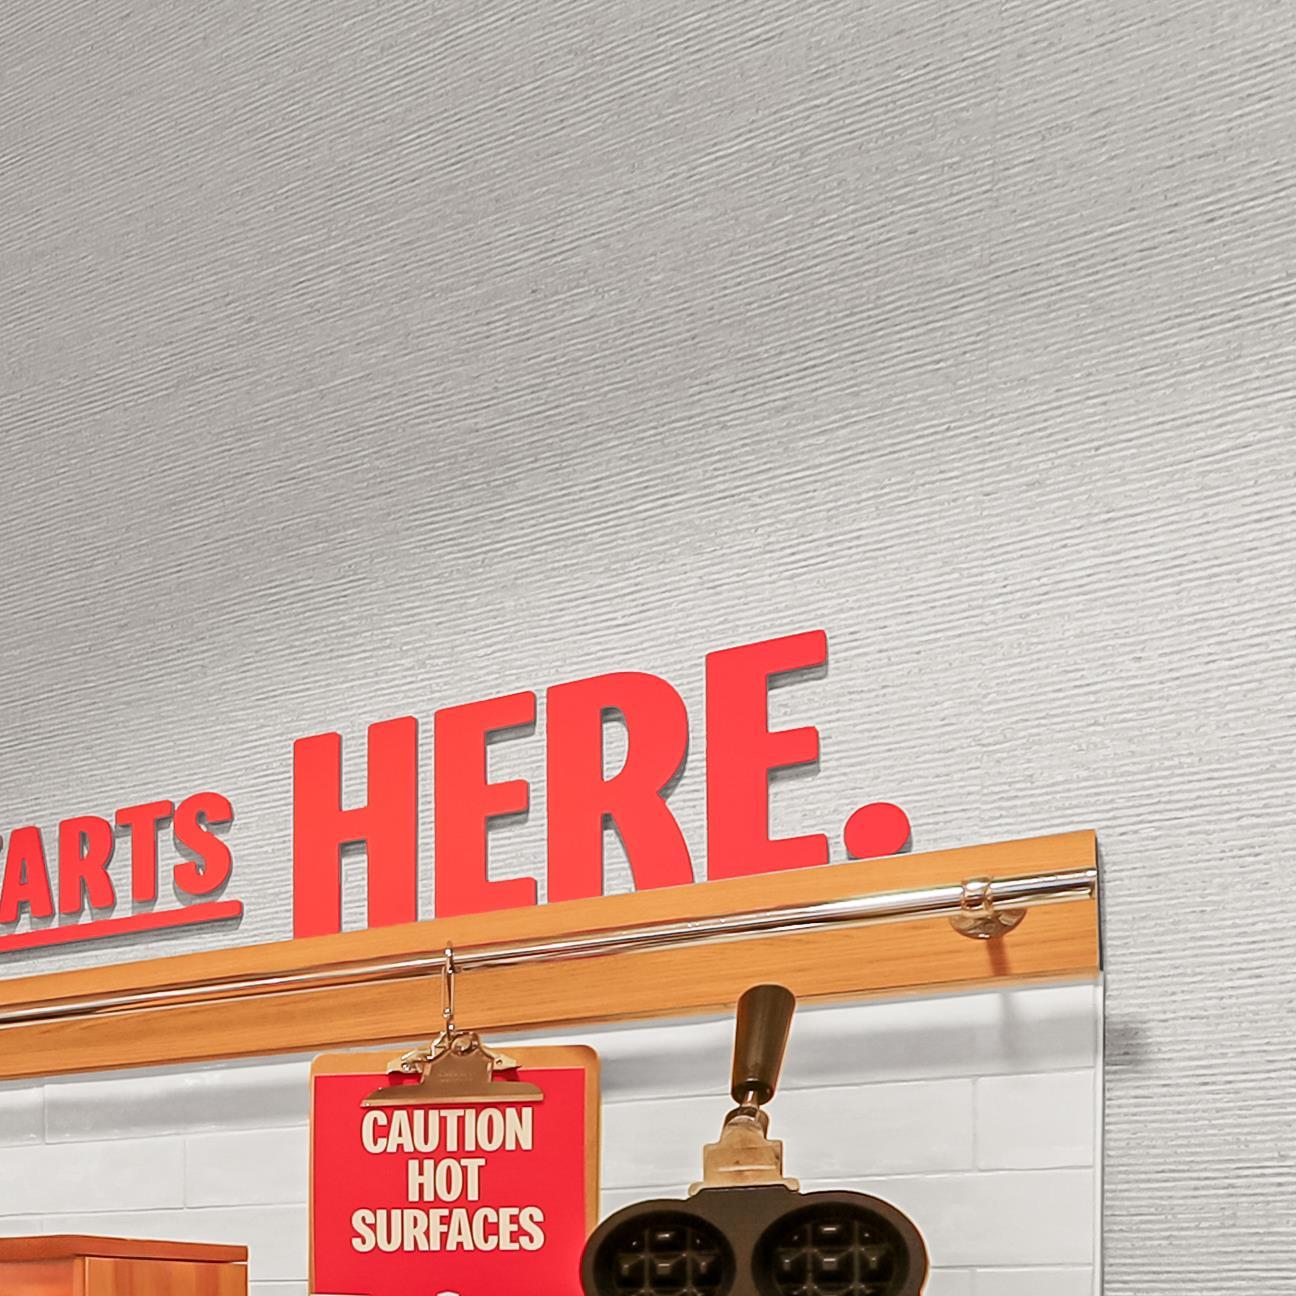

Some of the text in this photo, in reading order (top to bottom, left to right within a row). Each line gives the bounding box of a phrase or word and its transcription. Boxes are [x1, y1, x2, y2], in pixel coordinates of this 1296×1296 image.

[292, 629, 911, 939] HERE.
[362, 1106, 534, 1154] CAUTION
[407, 1157, 486, 1202] HOT
[351, 1206, 545, 1252] SURFACES
